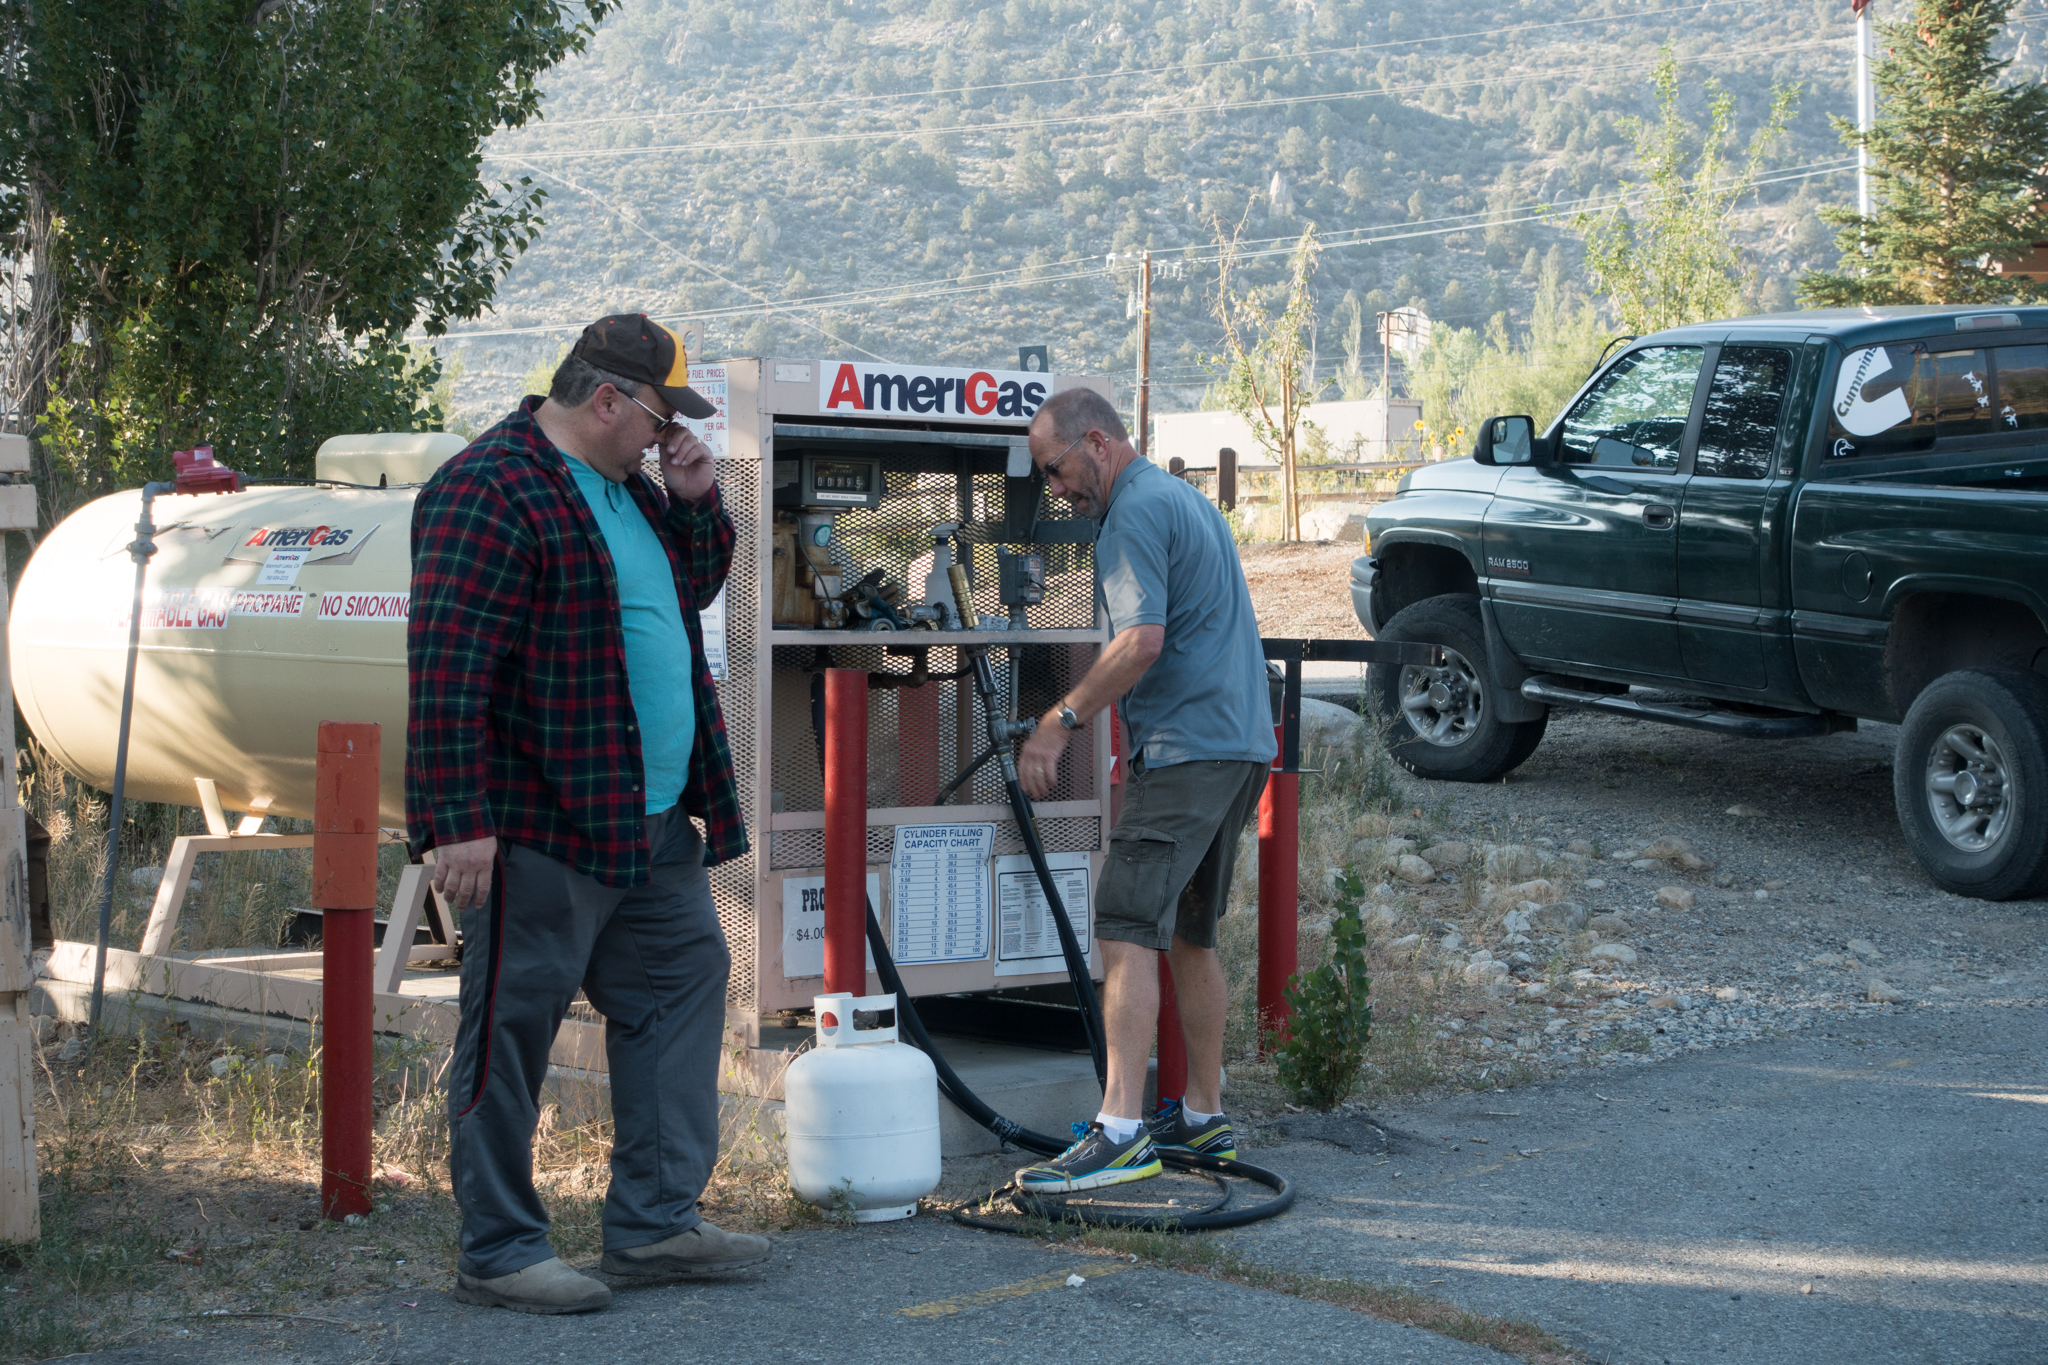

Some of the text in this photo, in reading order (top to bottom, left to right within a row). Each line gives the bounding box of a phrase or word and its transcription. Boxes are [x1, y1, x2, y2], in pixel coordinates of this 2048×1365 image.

[692, 370, 704, 378] FUEL
[707, 368, 725, 378] PRICES
[1836, 347, 1878, 417] Cummins
[826, 364, 1047, 416] AmeriGas
[716, 397, 726, 405] GAL.
[716, 422, 727, 430] GAL.
[244, 526, 353, 546] AmeriGas
[1488, 557, 1505, 567] RAM
[234, 594, 303, 613] PROPANE
[319, 596, 342, 616] NO
[904, 829, 982, 838] CYLINDER FILLING
[904, 838, 980, 848] CAPACITY CHART
[802, 888, 825, 912] PRO
